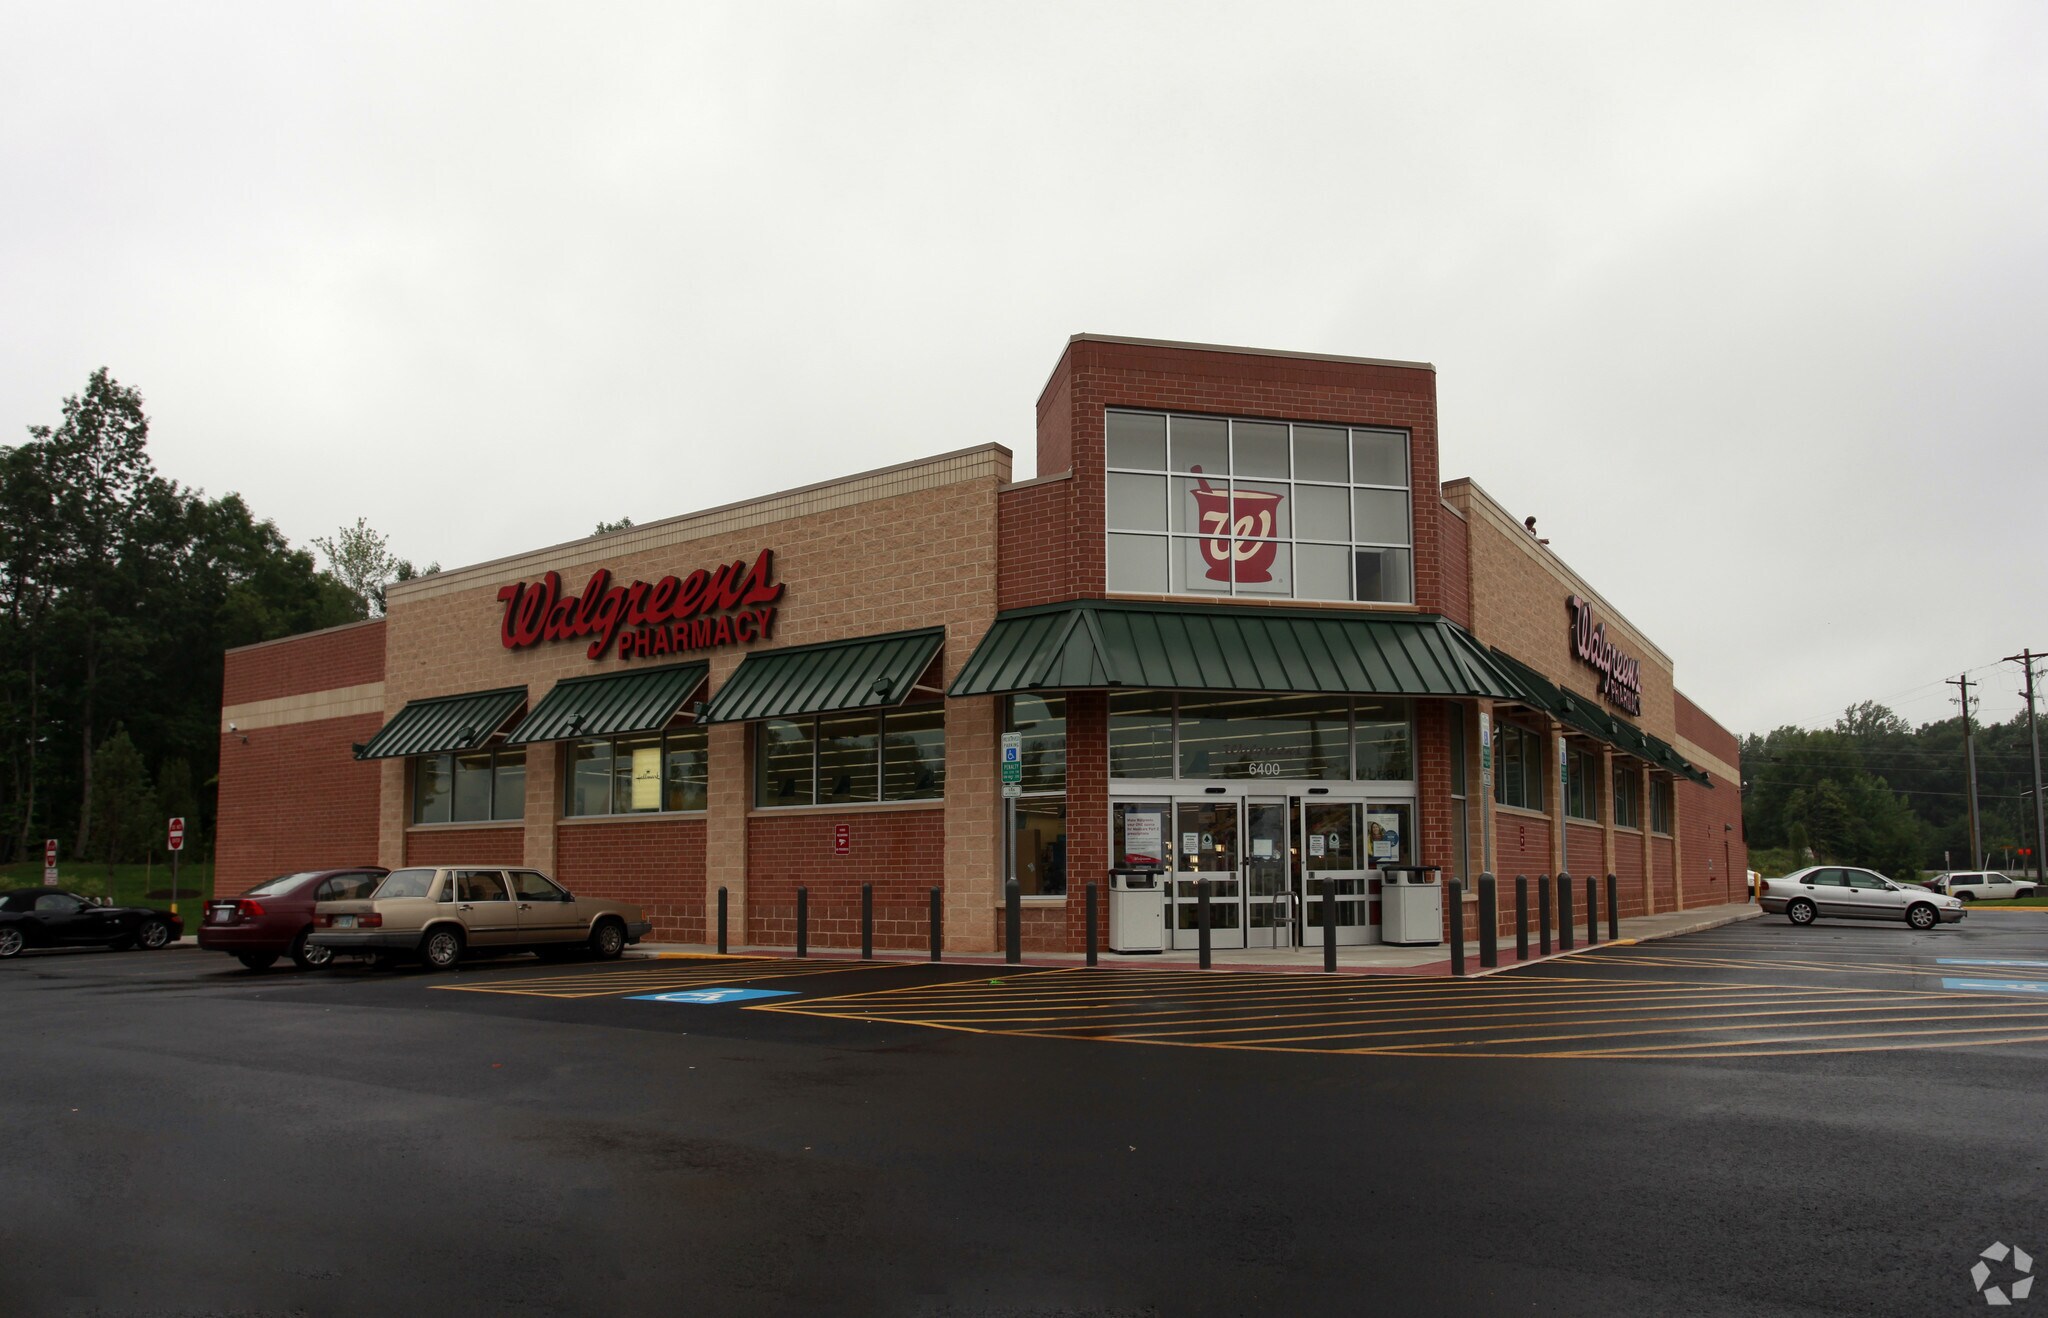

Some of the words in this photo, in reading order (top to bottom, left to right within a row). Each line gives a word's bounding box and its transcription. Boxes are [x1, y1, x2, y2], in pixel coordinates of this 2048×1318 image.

[497, 548, 785, 660] Walgreens
[618, 607, 777, 660] PHARMACY
[1568, 595, 1642, 694] Walgreens
[1249, 763, 1280, 776] 6400
